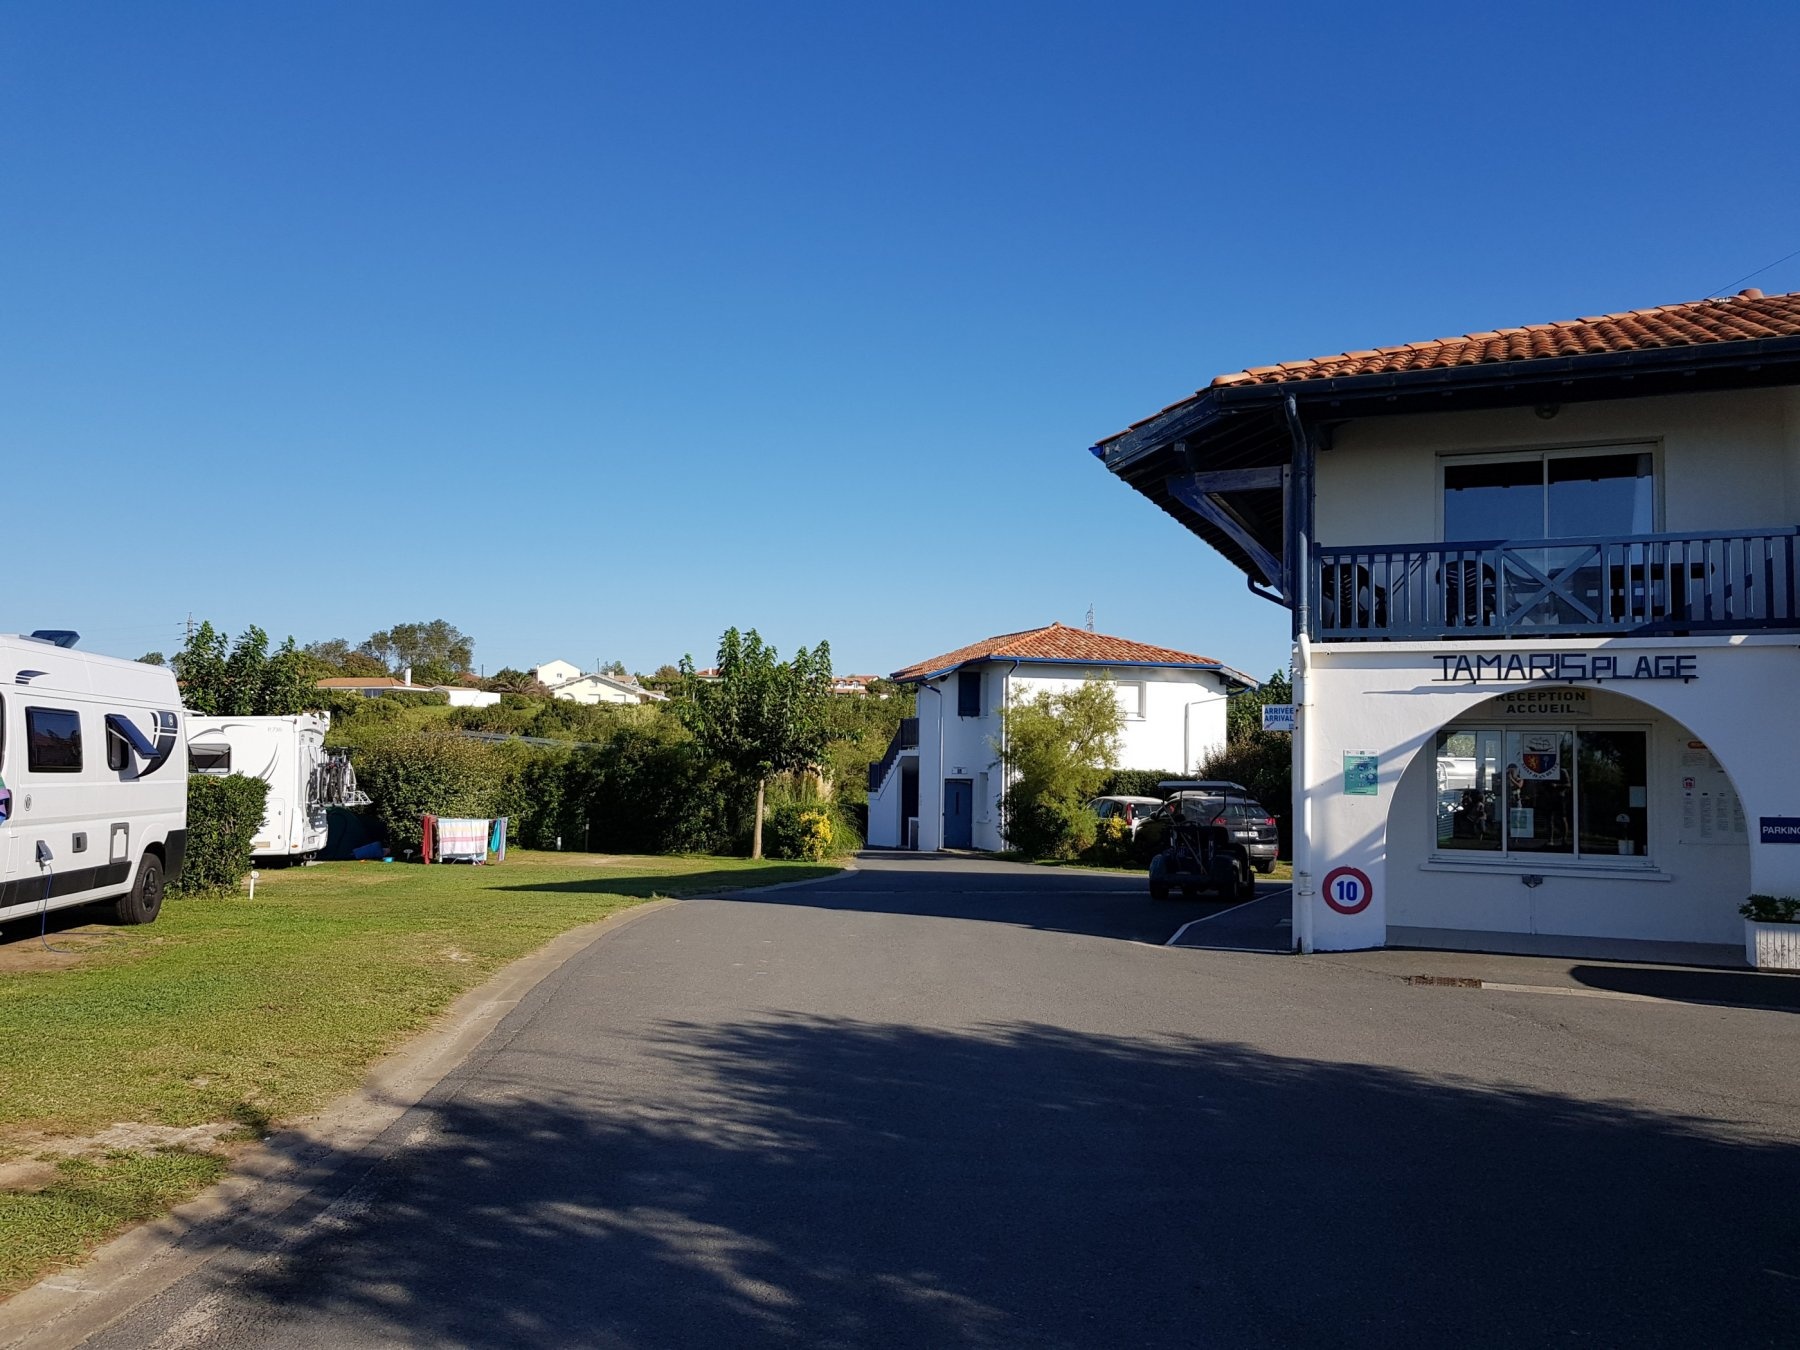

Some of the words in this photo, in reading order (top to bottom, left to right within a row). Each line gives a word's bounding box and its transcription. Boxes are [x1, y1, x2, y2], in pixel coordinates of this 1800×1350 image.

[1433, 653, 1586, 681] TAMARIS
[1592, 655, 1696, 679] PLAGE
[1495, 691, 1586, 702] RECEPTION
[1264, 705, 1294, 714] ARRIVÉE
[1506, 703, 1576, 714] ACCUEIL
[1336, 880, 1358, 901] 10
